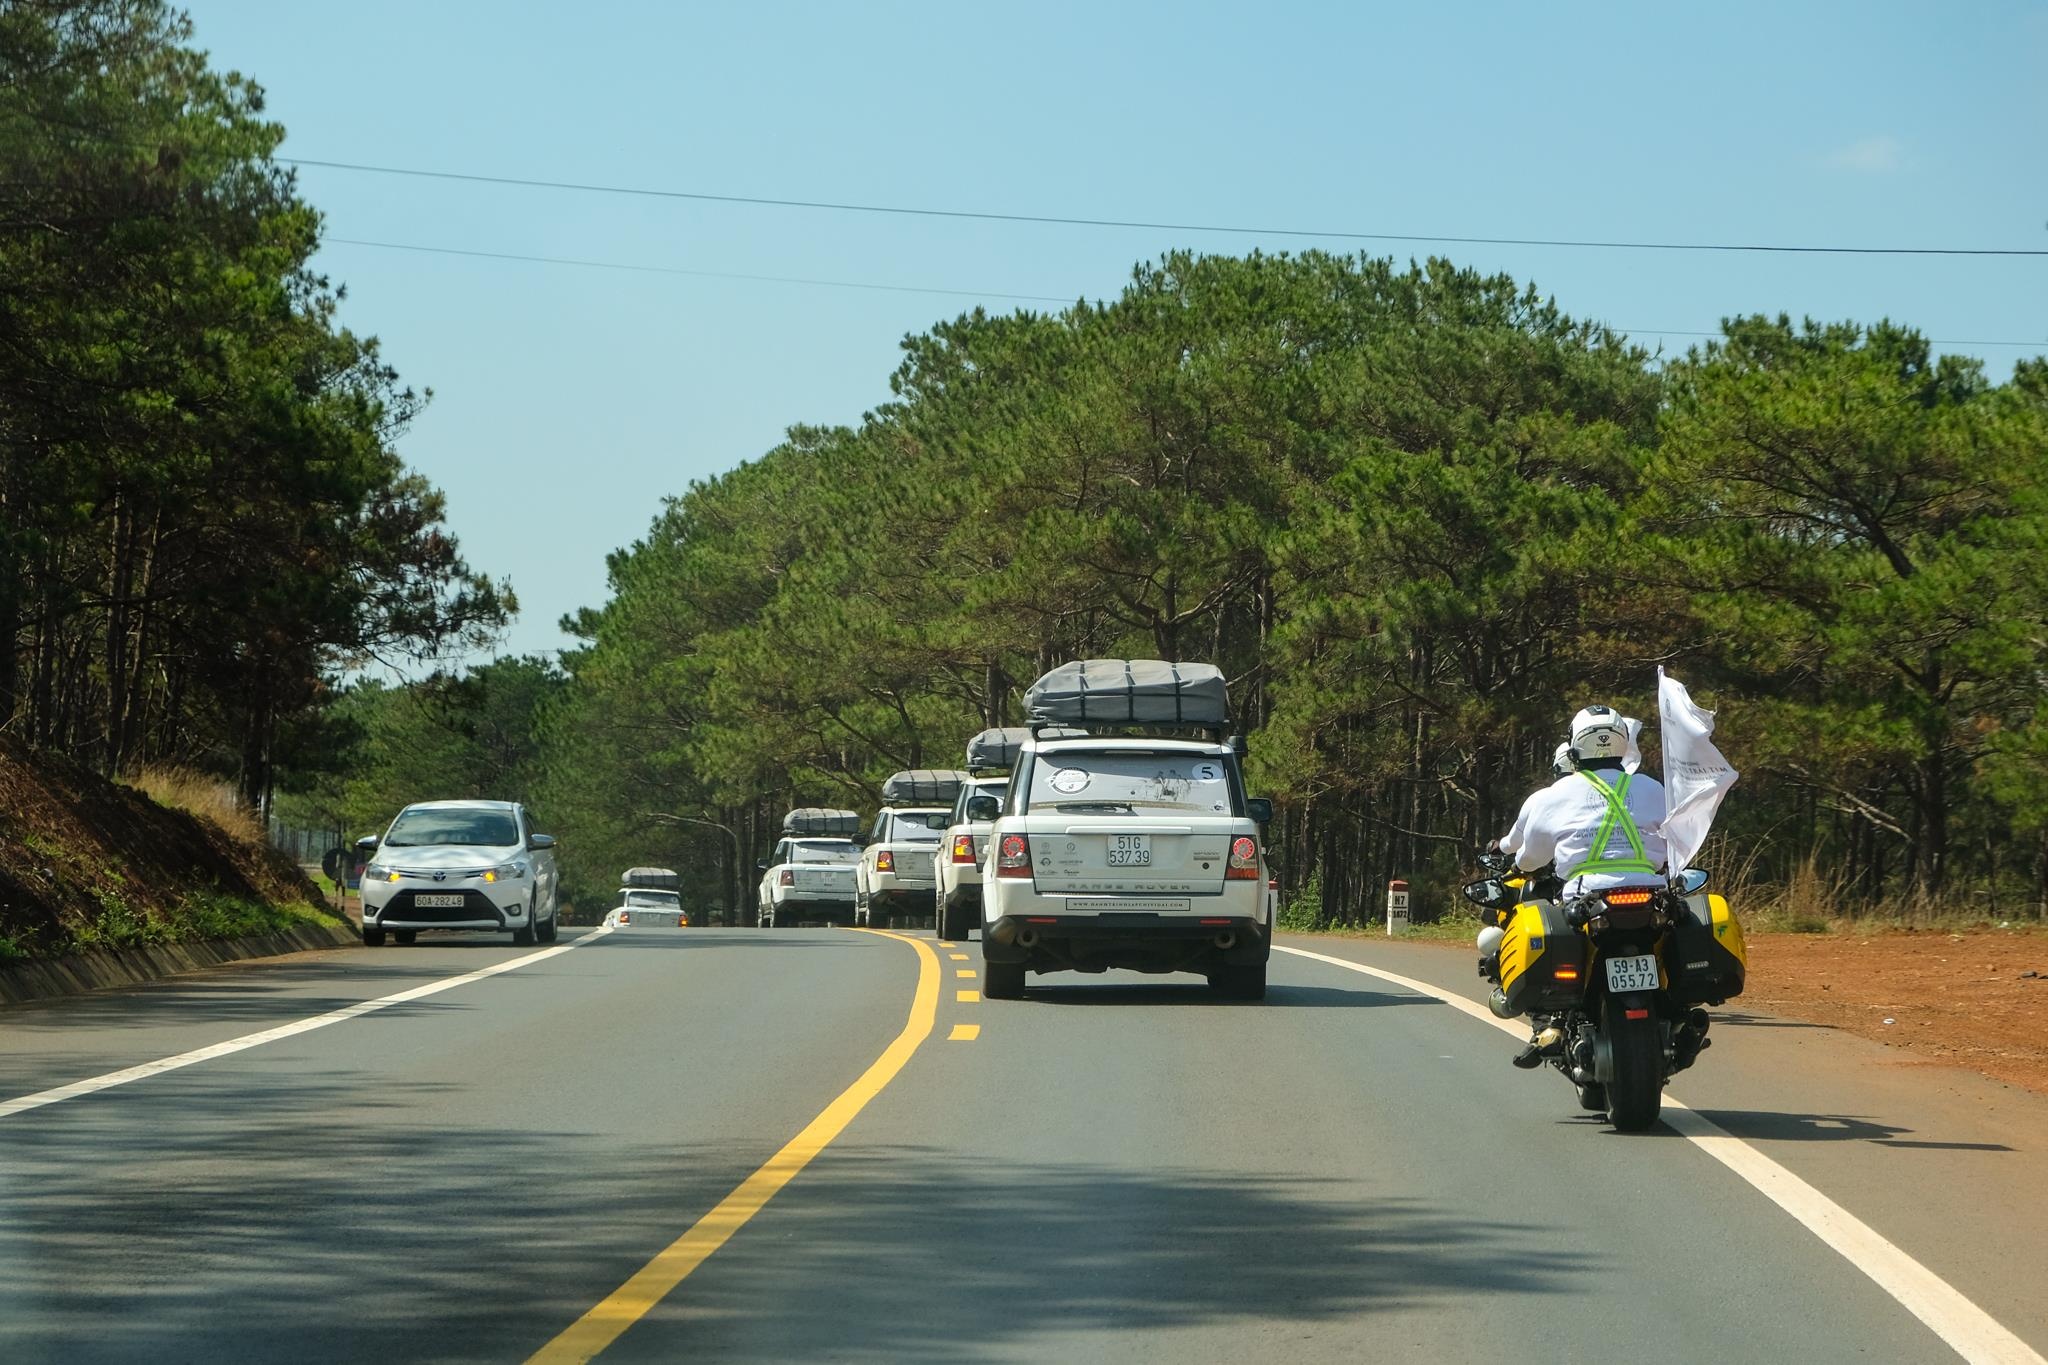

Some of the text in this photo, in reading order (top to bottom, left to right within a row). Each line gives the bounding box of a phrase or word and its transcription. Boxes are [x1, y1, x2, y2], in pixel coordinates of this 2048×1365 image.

[1201, 766, 1213, 779] 5
[1118, 836, 1141, 849] 51G
[1109, 850, 1150, 864] 537.39
[1394, 895, 1405, 904] H7
[1613, 958, 1649, 974] 59-A3
[1611, 973, 1656, 989] 055.72
